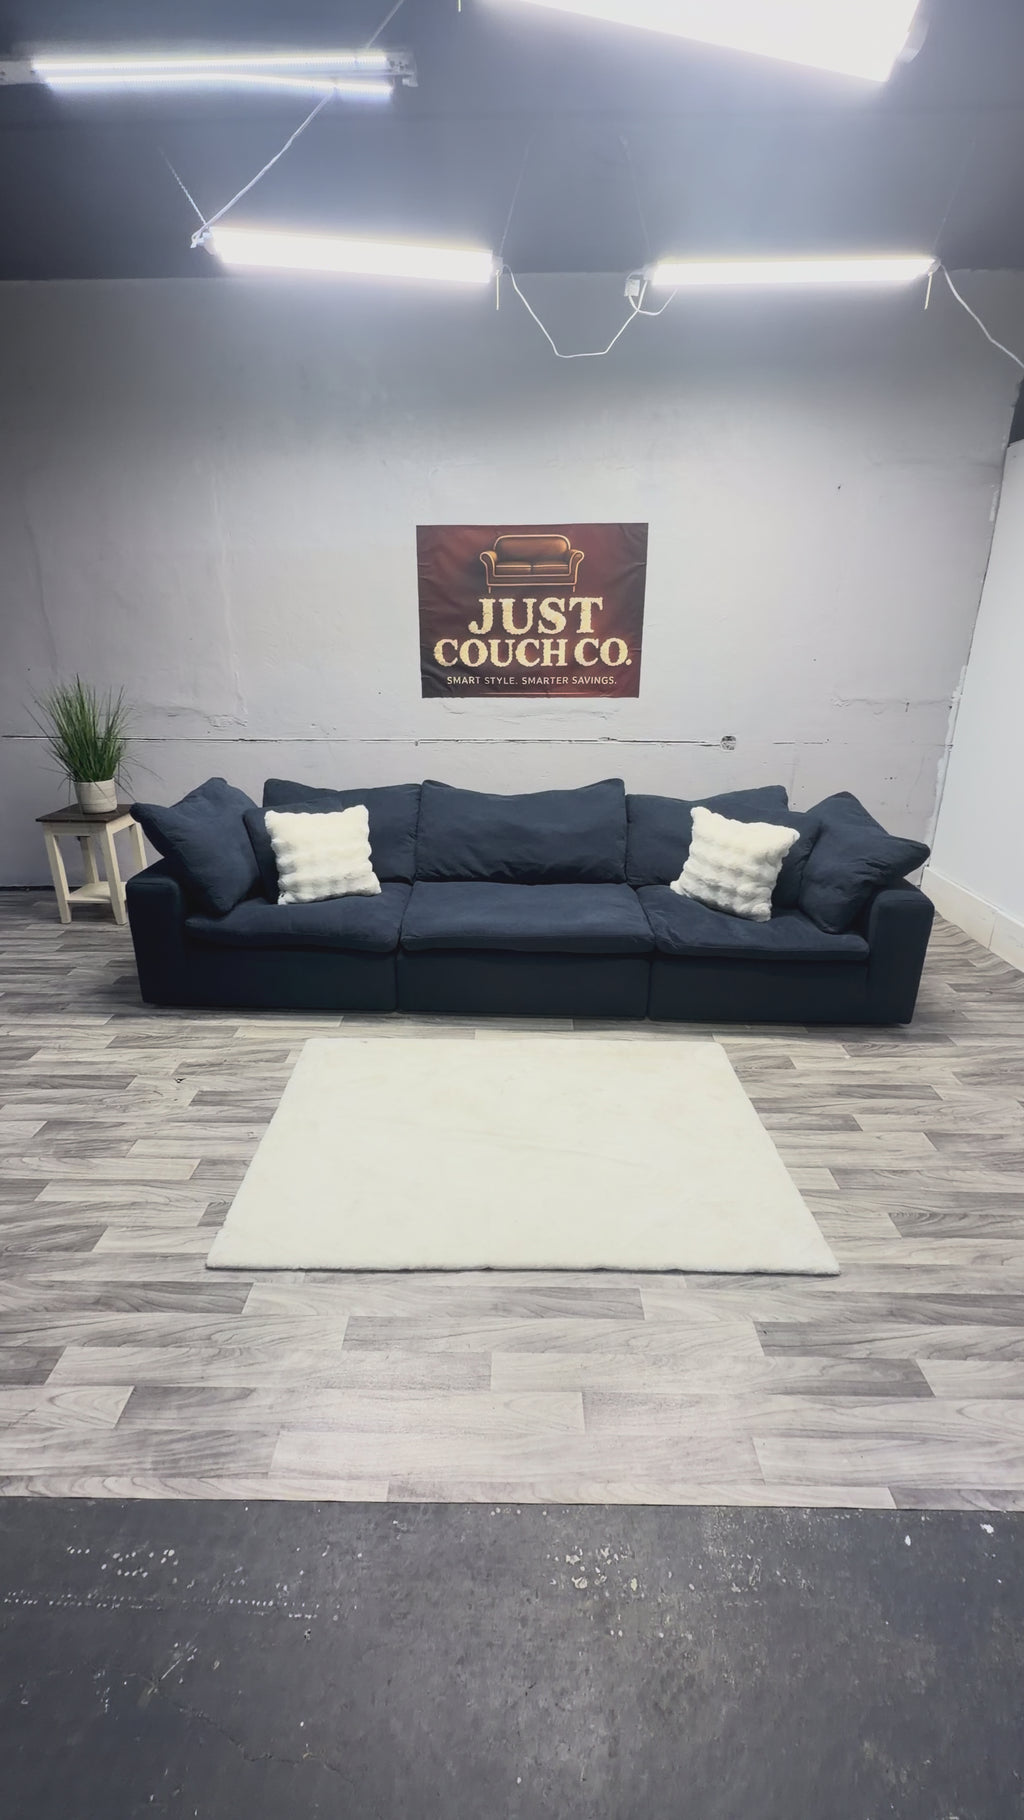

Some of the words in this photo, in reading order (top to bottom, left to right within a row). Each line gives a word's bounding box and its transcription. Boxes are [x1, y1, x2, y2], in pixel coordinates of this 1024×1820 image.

[468, 597, 603, 635] JUST
[433, 638, 568, 667] COUCH
[574, 637, 632, 667] CO.
[447, 676, 480, 685] SMART
[484, 676, 518, 685] STYLE.
[521, 676, 569, 685] SMARTER
[572, 676, 617, 685] SAVINGS.
